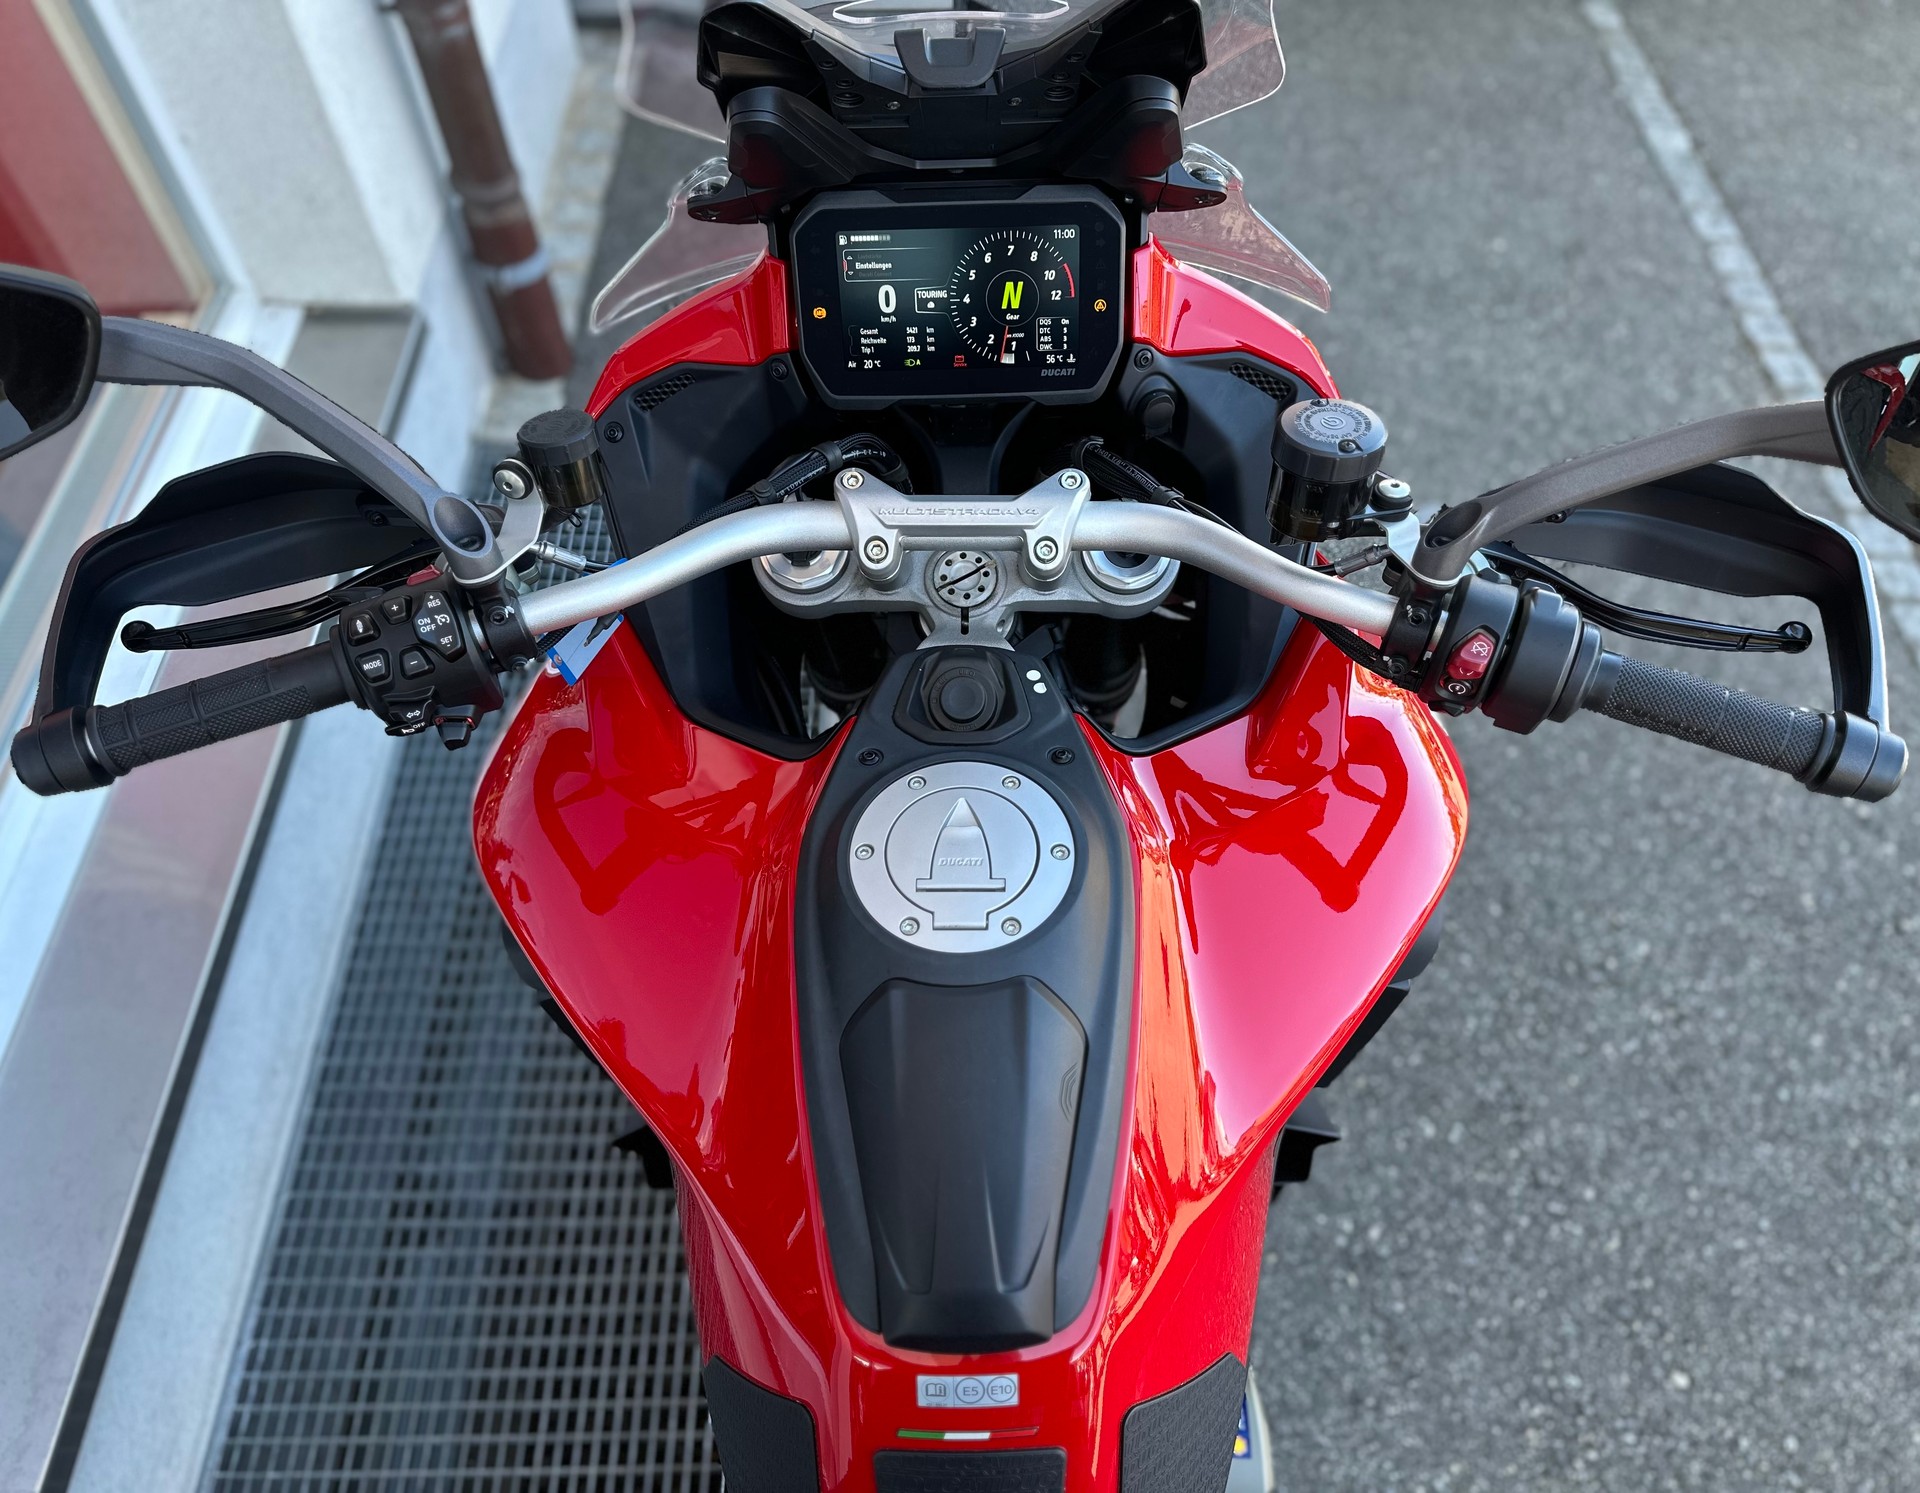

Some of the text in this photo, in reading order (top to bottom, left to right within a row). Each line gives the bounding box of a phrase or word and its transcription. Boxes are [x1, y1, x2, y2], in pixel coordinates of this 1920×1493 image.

[1053, 229, 1075, 239] 11:00
[1007, 245, 1014, 256] 7
[984, 252, 992, 263] 6
[1030, 251, 1038, 262] 8
[855, 262, 892, 271] Einstellungen
[969, 270, 976, 281] 5
[1044, 270, 1056, 281] 10
[878, 284, 896, 313] 0
[917, 290, 947, 299] TOURING
[963, 293, 970, 304] 4
[1001, 281, 1024, 309] N
[1051, 290, 1061, 300] 12
[970, 316, 977, 327] 3
[987, 334, 995, 344] 2
[1011, 341, 1016, 351] 1
[1046, 354, 1055, 363] 56
[863, 360, 873, 368] 20
[1041, 368, 1076, 376] DUCATI
[879, 507, 1039, 516] MULTISTRADA V4
[427, 599, 441, 608] RES
[417, 617, 431, 626] ON
[420, 624, 436, 633] OFF
[440, 636, 453, 645] SET
[363, 659, 382, 671] MODE
[938, 857, 983, 867] DUCATI
[963, 1384, 1012, 1396] E5 E10
